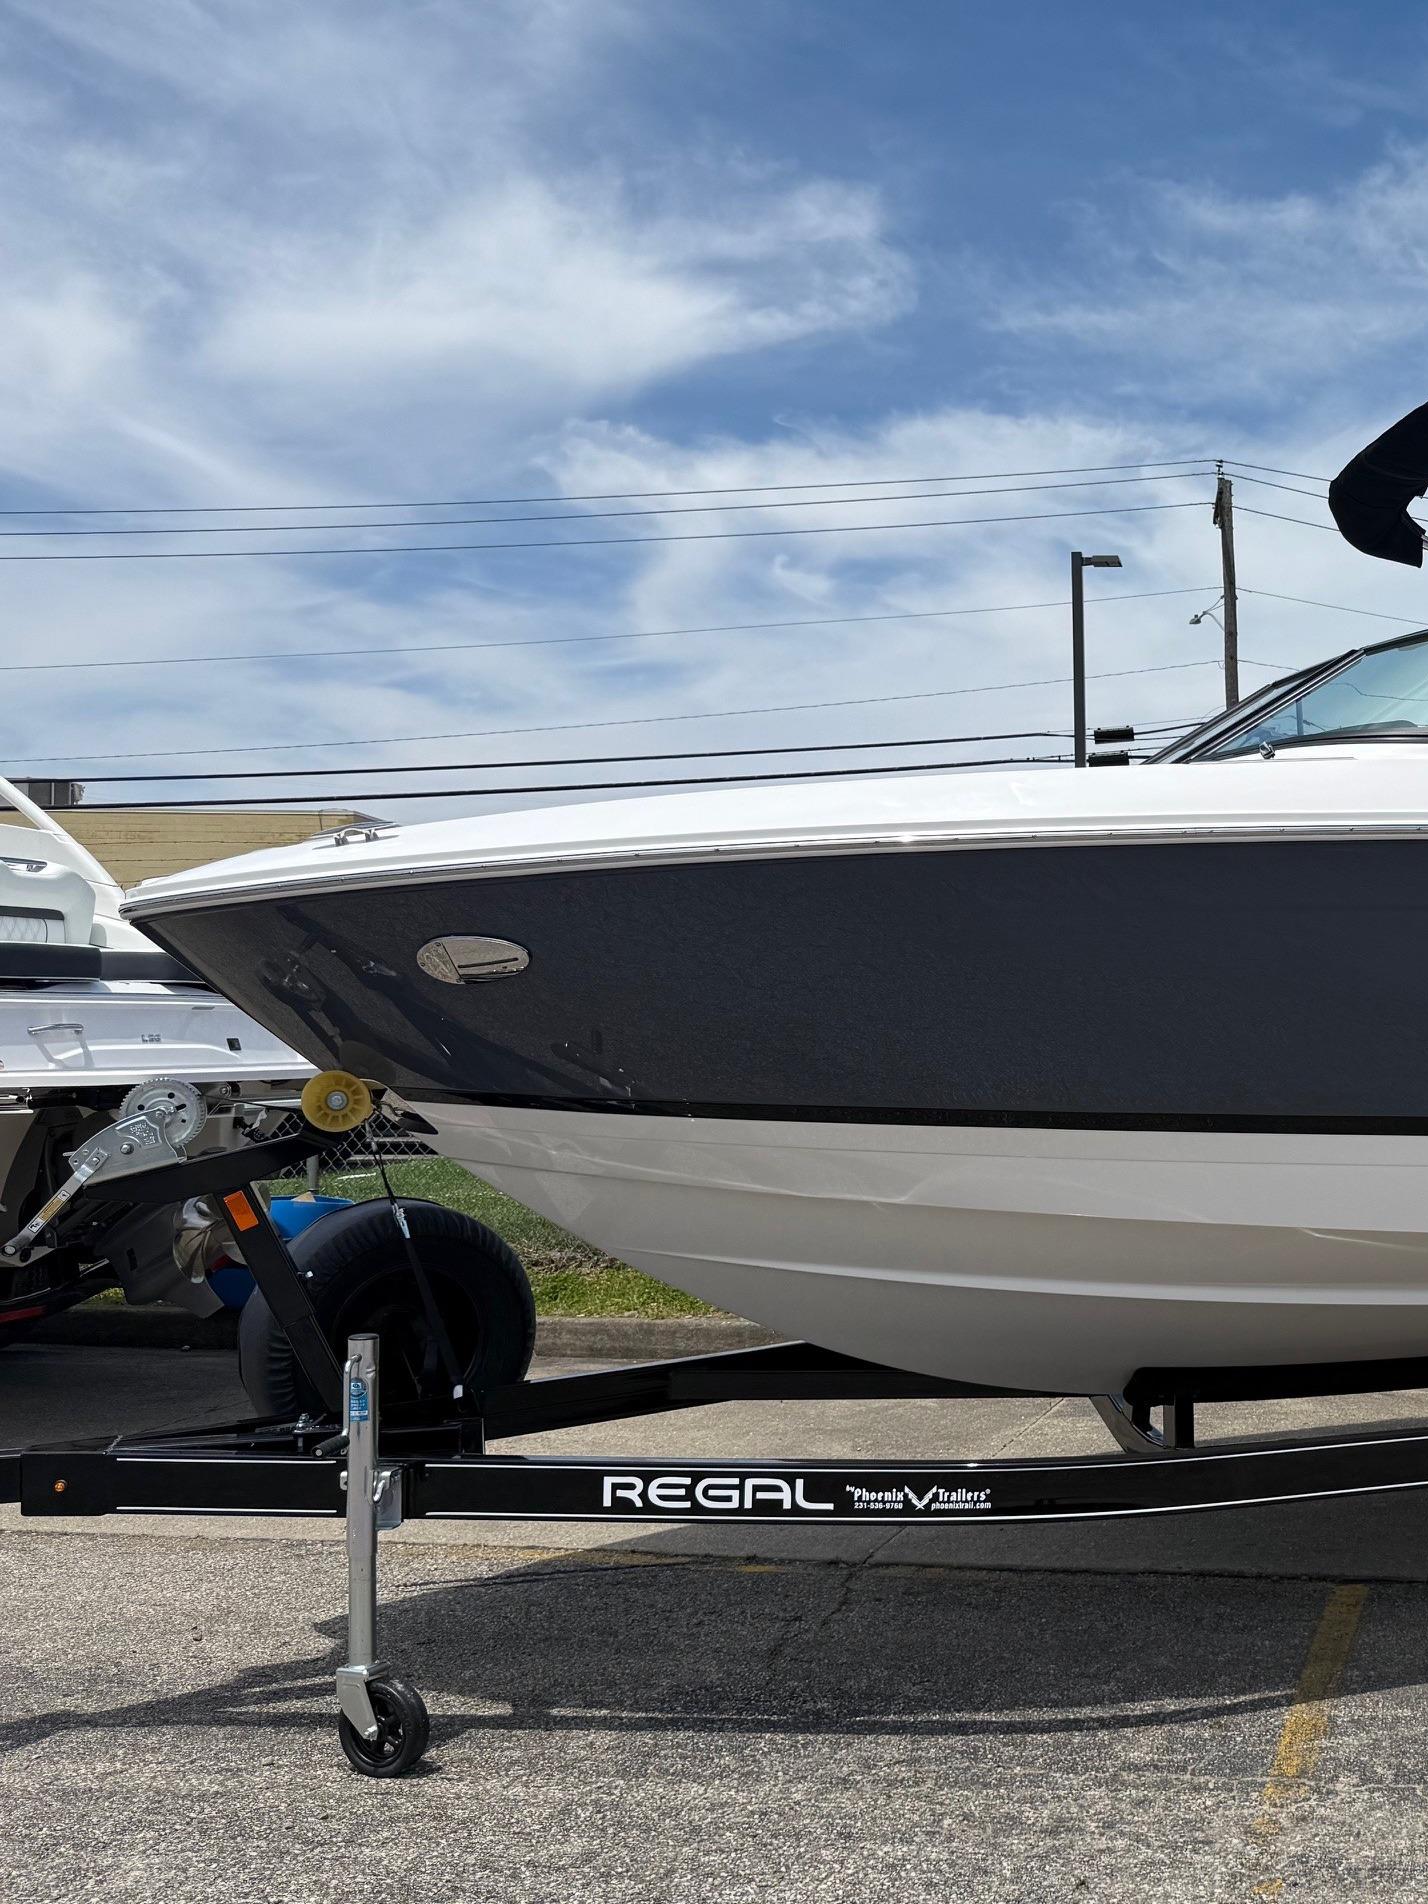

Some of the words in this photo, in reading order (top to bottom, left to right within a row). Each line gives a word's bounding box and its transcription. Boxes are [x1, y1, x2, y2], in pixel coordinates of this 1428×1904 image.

[602, 1476, 834, 1511] REGAL
[854, 1488, 904, 1501] Phoenix
[931, 1502, 992, 1511] phoenixtrail.com
